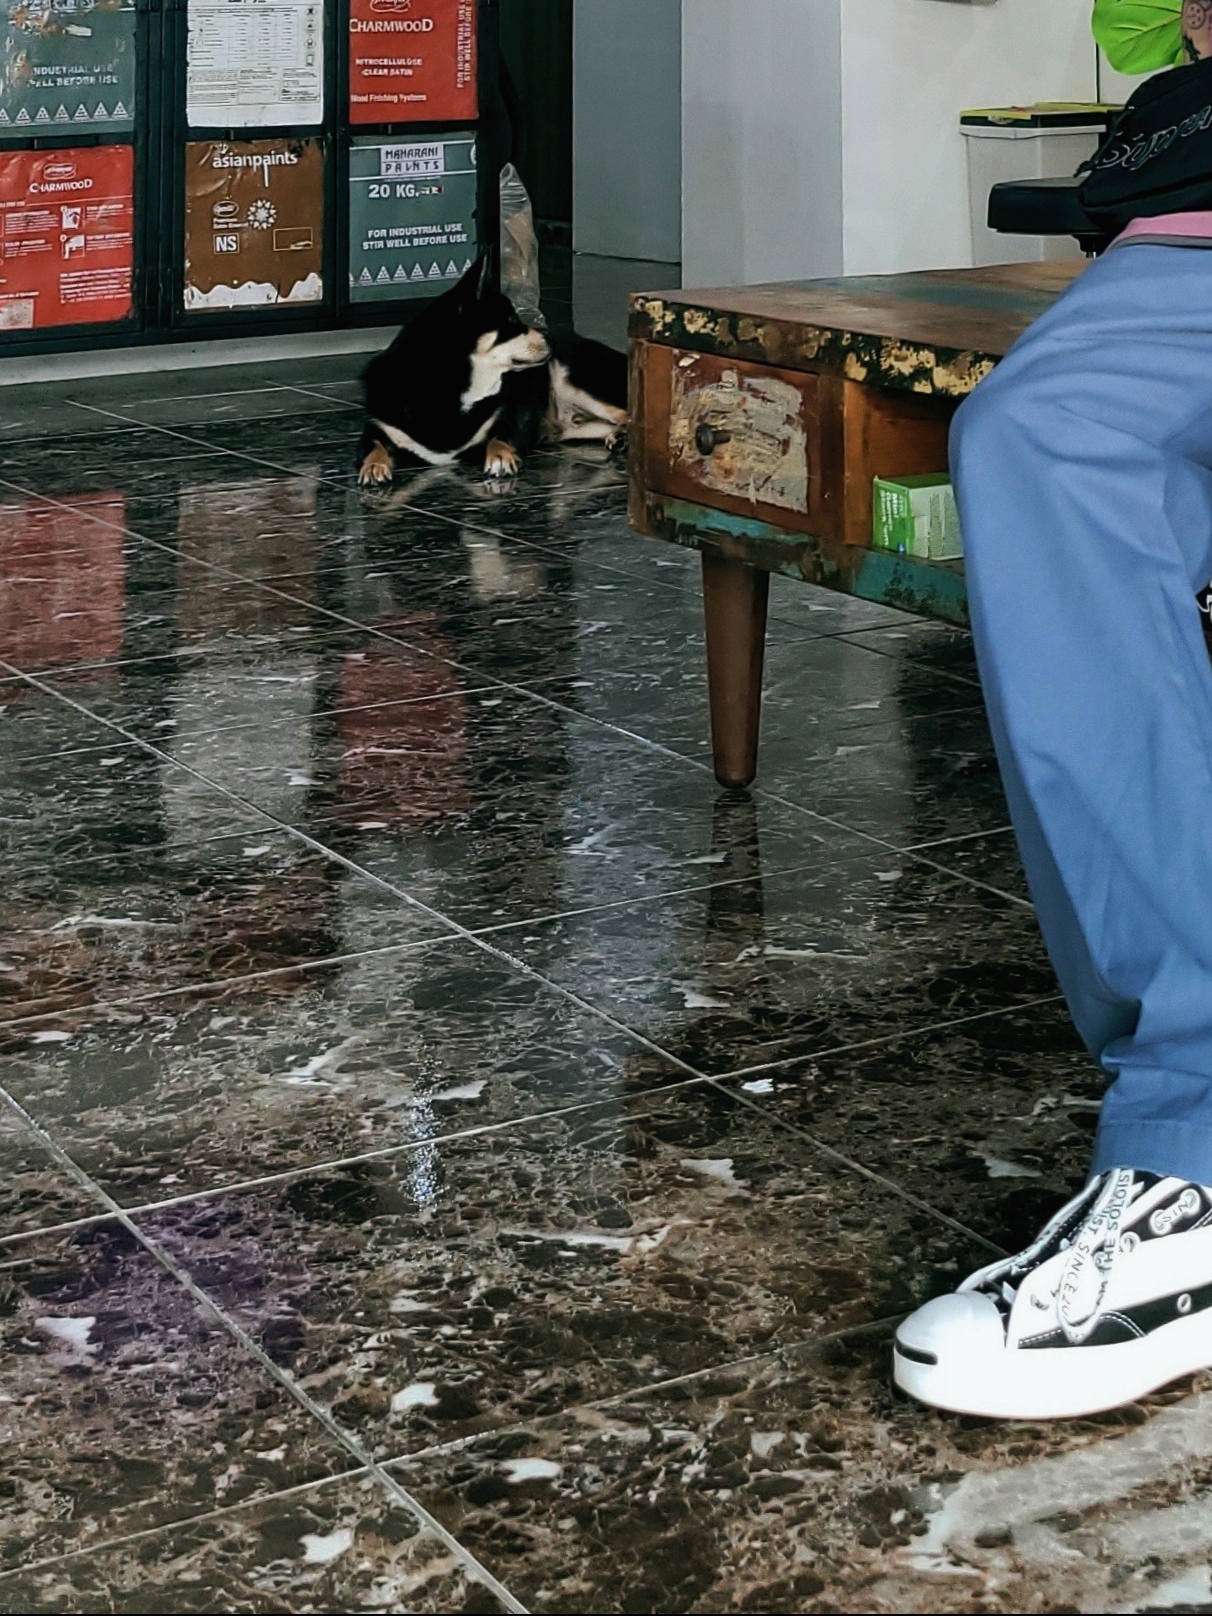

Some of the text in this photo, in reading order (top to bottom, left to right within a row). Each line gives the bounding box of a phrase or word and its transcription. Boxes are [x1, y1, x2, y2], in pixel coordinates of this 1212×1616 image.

[349, 18, 433, 32] CHARMWOOD
[385, 147, 438, 160] MAHARANI
[385, 161, 439, 173] PAINTS
[368, 184, 391, 198] 20
[368, 223, 463, 239] FOR INDUSTRIAL USE
[216, 236, 237, 252] NS
[362, 233, 468, 250] STIR WELL BEFORE USE
[1107, 1172, 1131, 1231] SOLOIS
